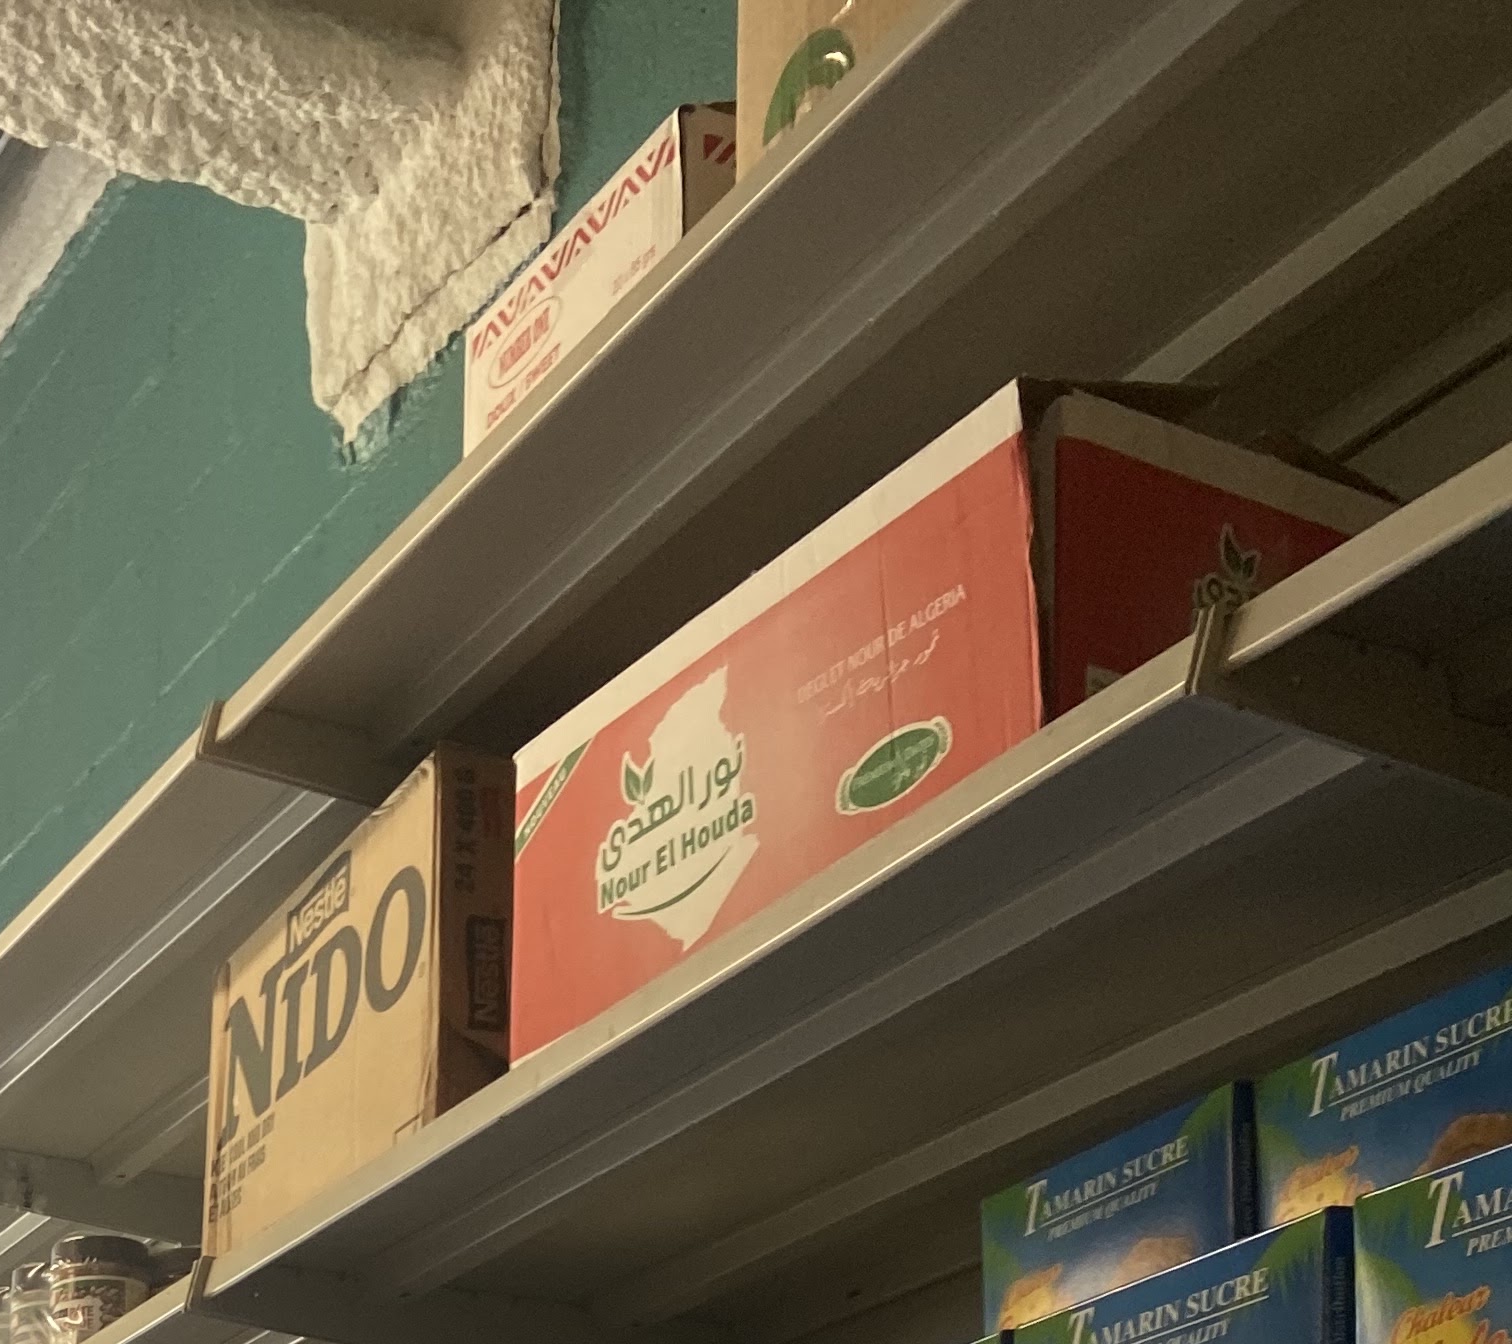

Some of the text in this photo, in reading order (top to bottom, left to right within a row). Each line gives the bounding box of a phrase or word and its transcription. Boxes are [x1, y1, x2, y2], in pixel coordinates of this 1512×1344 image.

[599, 797, 754, 909] Nour El Houda
[218, 865, 427, 1151] NIDO
[1308, 1035, 1431, 1119] TAMARIN
[1411, 1050, 1482, 1096] QUALITY
[1023, 1135, 1189, 1238] TAMARIN SUCRE
[1424, 1169, 1512, 1250] TAMA
[1466, 1226, 1512, 1258] PREM
[1185, 1267, 1271, 1319] SUCRE
